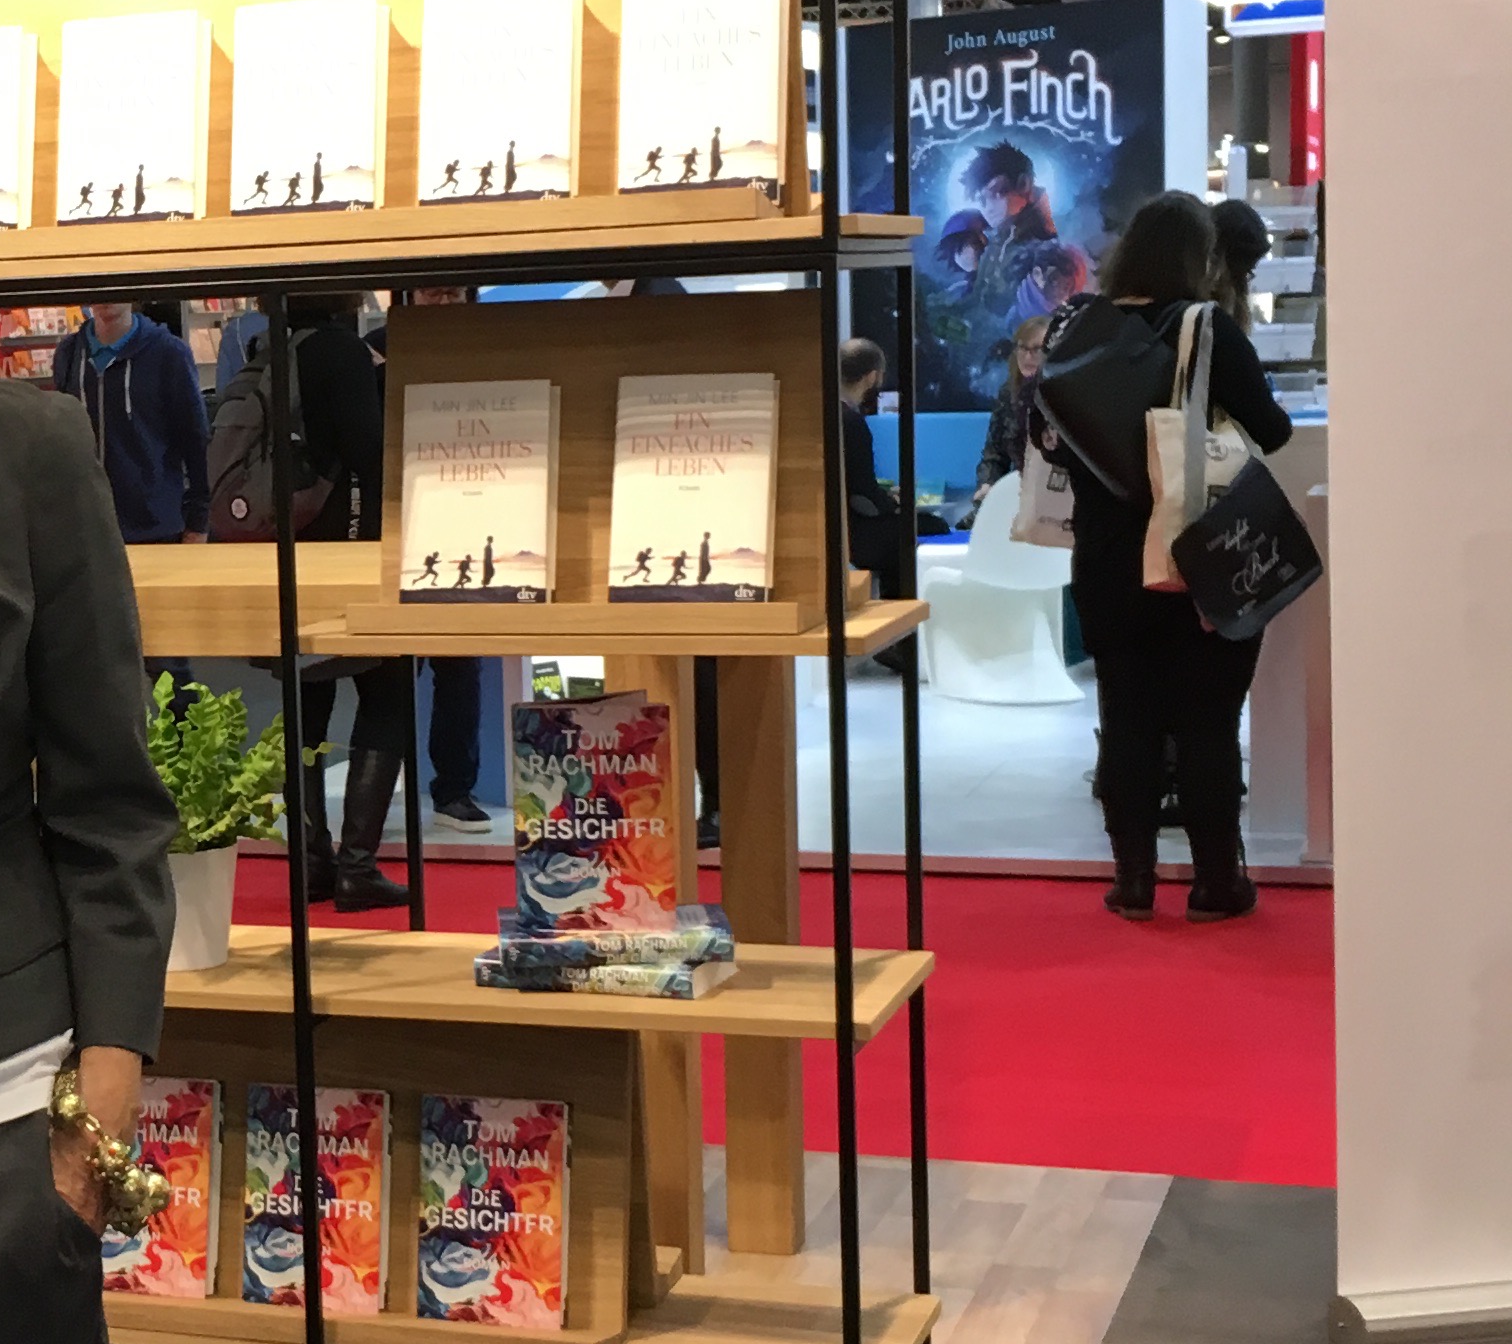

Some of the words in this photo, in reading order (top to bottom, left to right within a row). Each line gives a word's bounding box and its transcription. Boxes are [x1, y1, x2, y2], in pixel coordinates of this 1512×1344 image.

[945, 31, 987, 55] John
[994, 25, 1056, 48] August
[457, 419, 491, 437] EIN
[675, 412, 710, 430] EIN
[417, 440, 533, 461] EINFACHES
[631, 433, 754, 454] EINFACHES
[439, 463, 507, 483] LEBEN
[655, 457, 726, 476] LEBEN
[517, 588, 537, 600] dtv
[734, 585, 756, 599] dtv
[561, 729, 621, 751] TOM
[528, 753, 657, 776] RACHMAN
[525, 818, 666, 840] GESICHTER
[595, 939, 623, 952] TOM
[287, 1108, 337, 1132] TM
[463, 1120, 517, 1143] TOM
[257, 1131, 368, 1156] RACMAN
[431, 1143, 549, 1170] RACHMAN
[424, 1206, 555, 1236] GESICHTER
